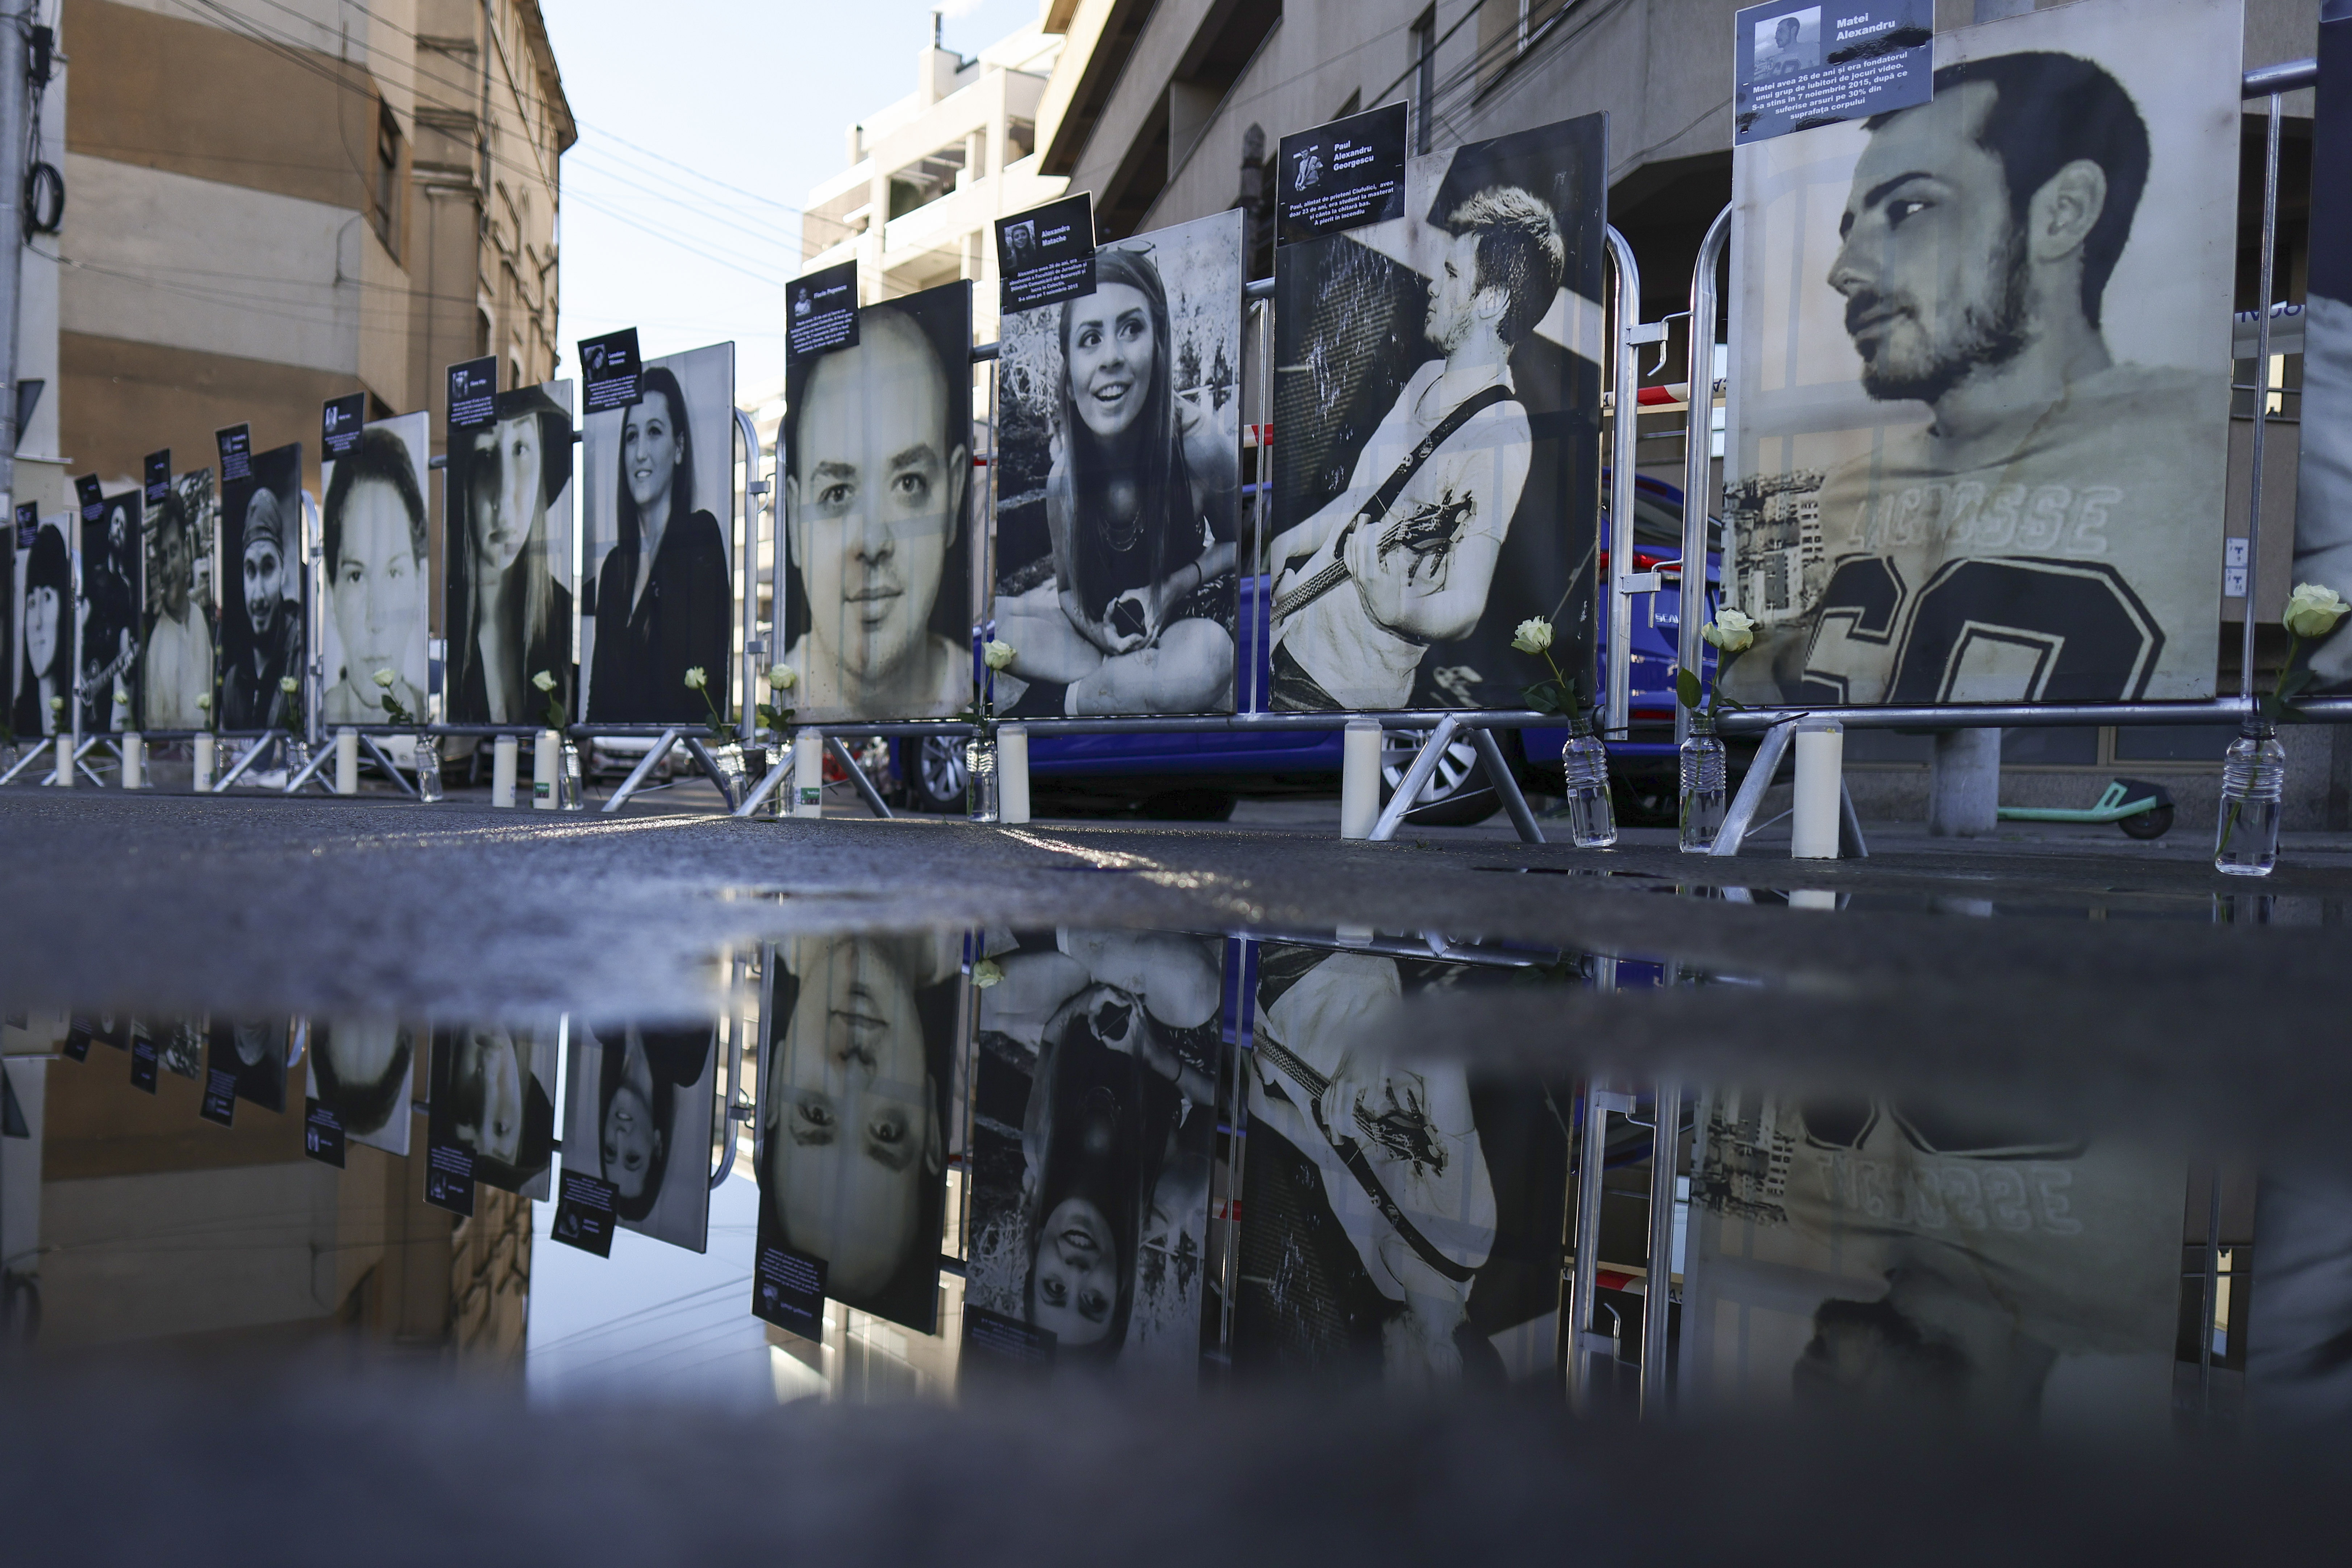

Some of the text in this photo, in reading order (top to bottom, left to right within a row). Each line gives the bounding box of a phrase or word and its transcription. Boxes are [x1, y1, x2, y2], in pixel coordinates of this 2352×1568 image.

[1837, 13, 1868, 28] Matei
[1836, 20, 1895, 41] Alexandru
[1753, 82, 1775, 93] Matei
[1777, 79, 1796, 87] avea
[1823, 68, 1835, 77] ani
[1864, 51, 1907, 67] fondatorul
[1756, 92, 1773, 101] unui
[1775, 88, 1793, 98] grup
[1807, 77, 1837, 89] iubitori
[1851, 68, 1876, 80] jocuri
[1878, 63, 1903, 72] video.
[1766, 99, 1786, 108] stins
[1805, 84, 1846, 99] noiembrie
[1848, 79, 1871, 89] 2015,
[1775, 103, 1807, 114] suferise
[1810, 95, 1833, 106] arsuri
[1848, 89, 1866, 97] 30%
[1831, 97, 1865, 111] corpului
[1334, 140, 1350, 151] Paul
[1334, 146, 1372, 162] Alexandru
[1333, 155, 1374, 171] Georgescu
[1290, 203, 1303, 211] Paul,
[1304, 198, 1321, 207] alintat
[1330, 190, 1351, 201] prieteni
[1339, 195, 1360, 205] student
[1368, 187, 1394, 198] masterat
[1319, 216, 1334, 225] pierit
[1341, 208, 1365, 219] incendiu
[1041, 225, 1070, 238] Alexandra
